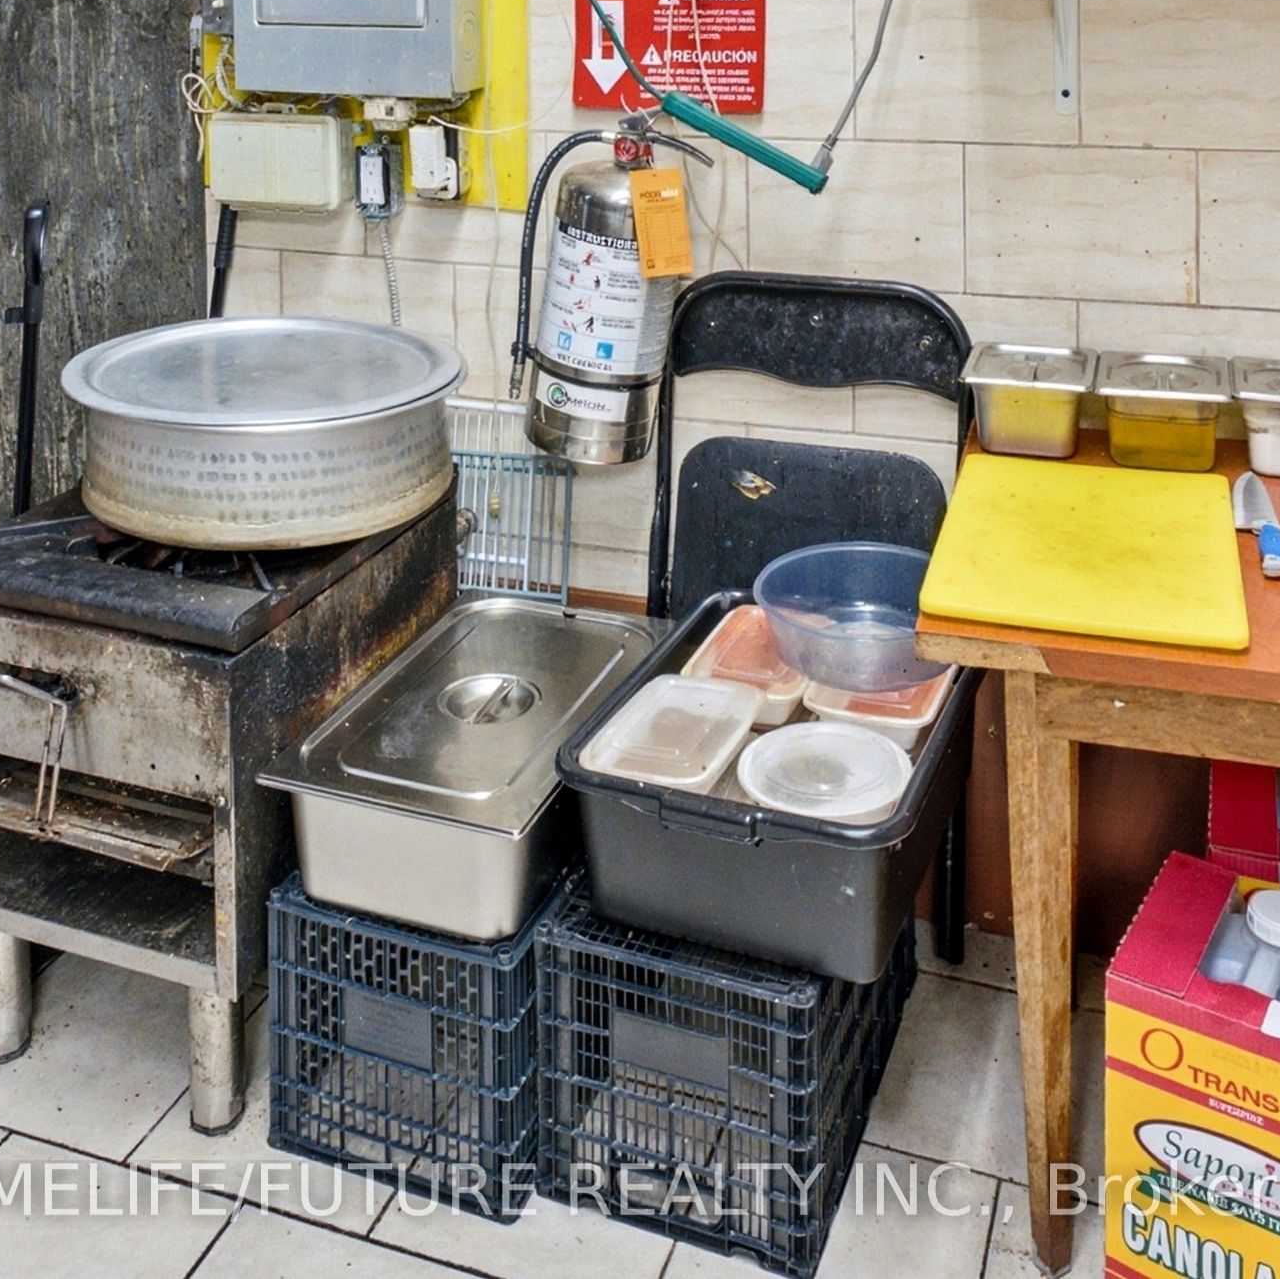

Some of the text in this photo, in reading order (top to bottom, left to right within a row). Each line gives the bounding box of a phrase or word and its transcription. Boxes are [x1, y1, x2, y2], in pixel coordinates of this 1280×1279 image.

[663, 46, 758, 64] PRECAUCIÓN
[1187, 1064, 1280, 1114] TRANS
[1188, 1187, 1229, 1211] NAME
[1230, 1201, 1266, 1226] SAYS
